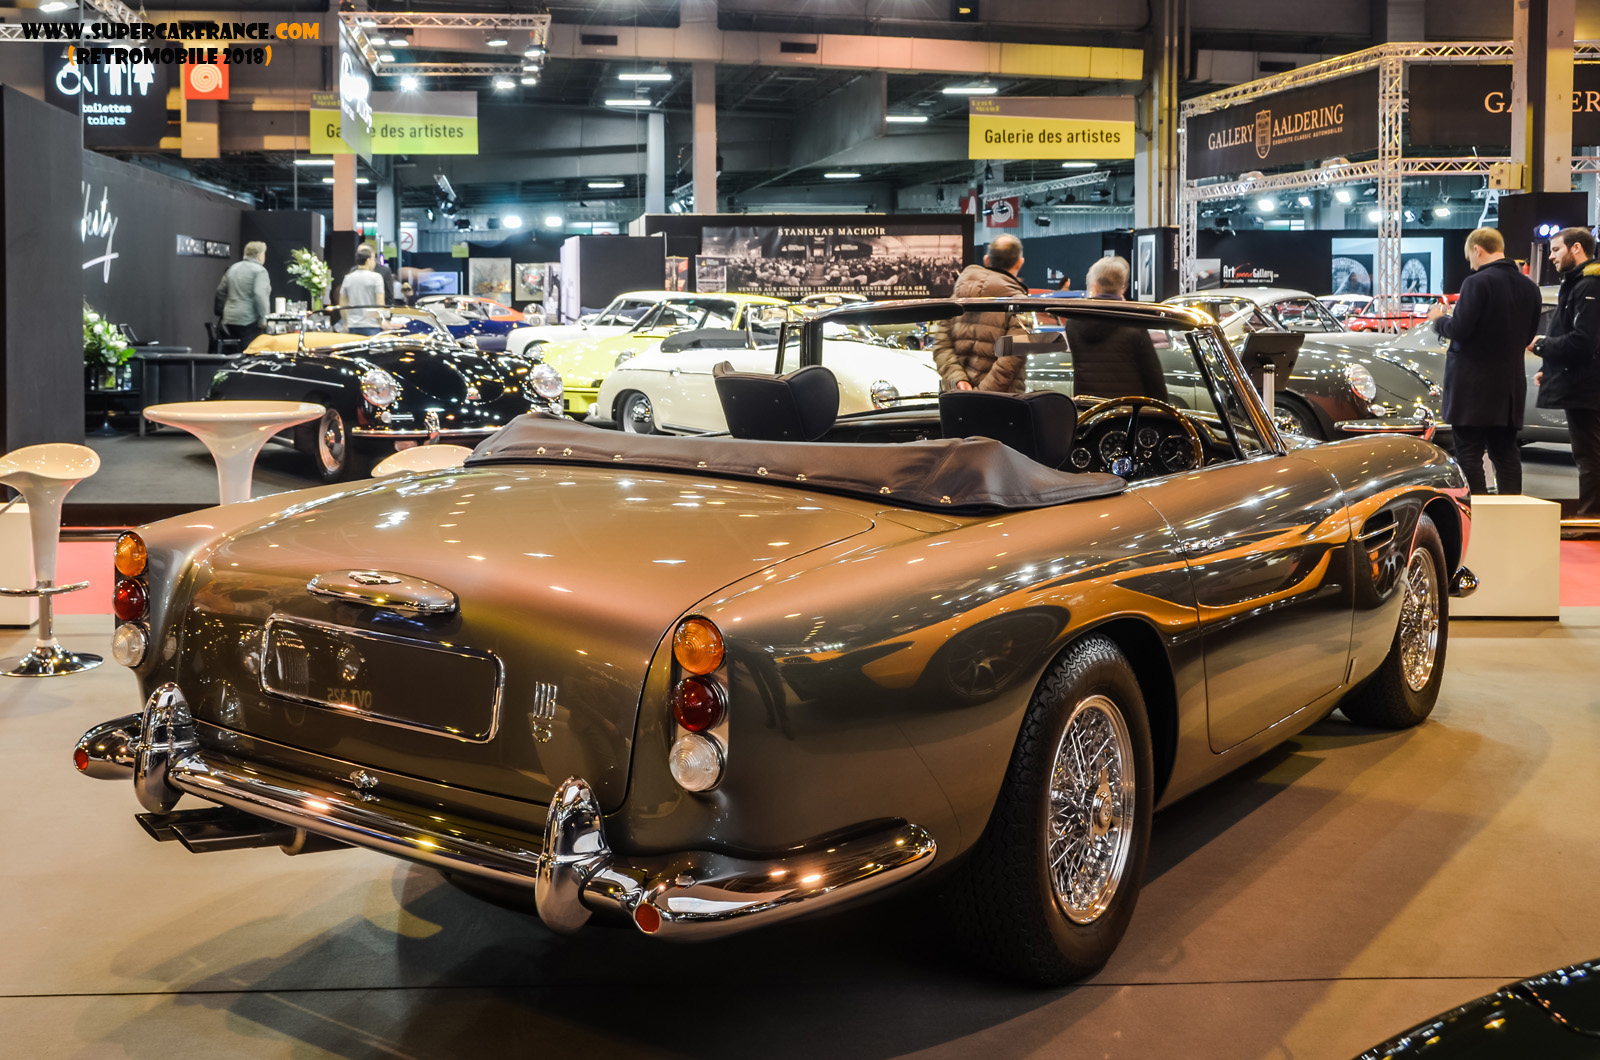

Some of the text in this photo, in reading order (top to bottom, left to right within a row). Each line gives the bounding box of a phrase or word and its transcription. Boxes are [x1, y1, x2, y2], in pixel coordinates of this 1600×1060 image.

[82, 103, 132, 113] toilettes
[87, 115, 126, 126] toilets
[381, 124, 404, 138] des
[410, 124, 464, 138] artistes
[1208, 104, 1344, 151] GALLERY AALDERING
[985, 129, 1121, 143] Galerie des artistes
[1294, 132, 1312, 142] CLASSIC
[778, 227, 834, 236] STANISLAS
